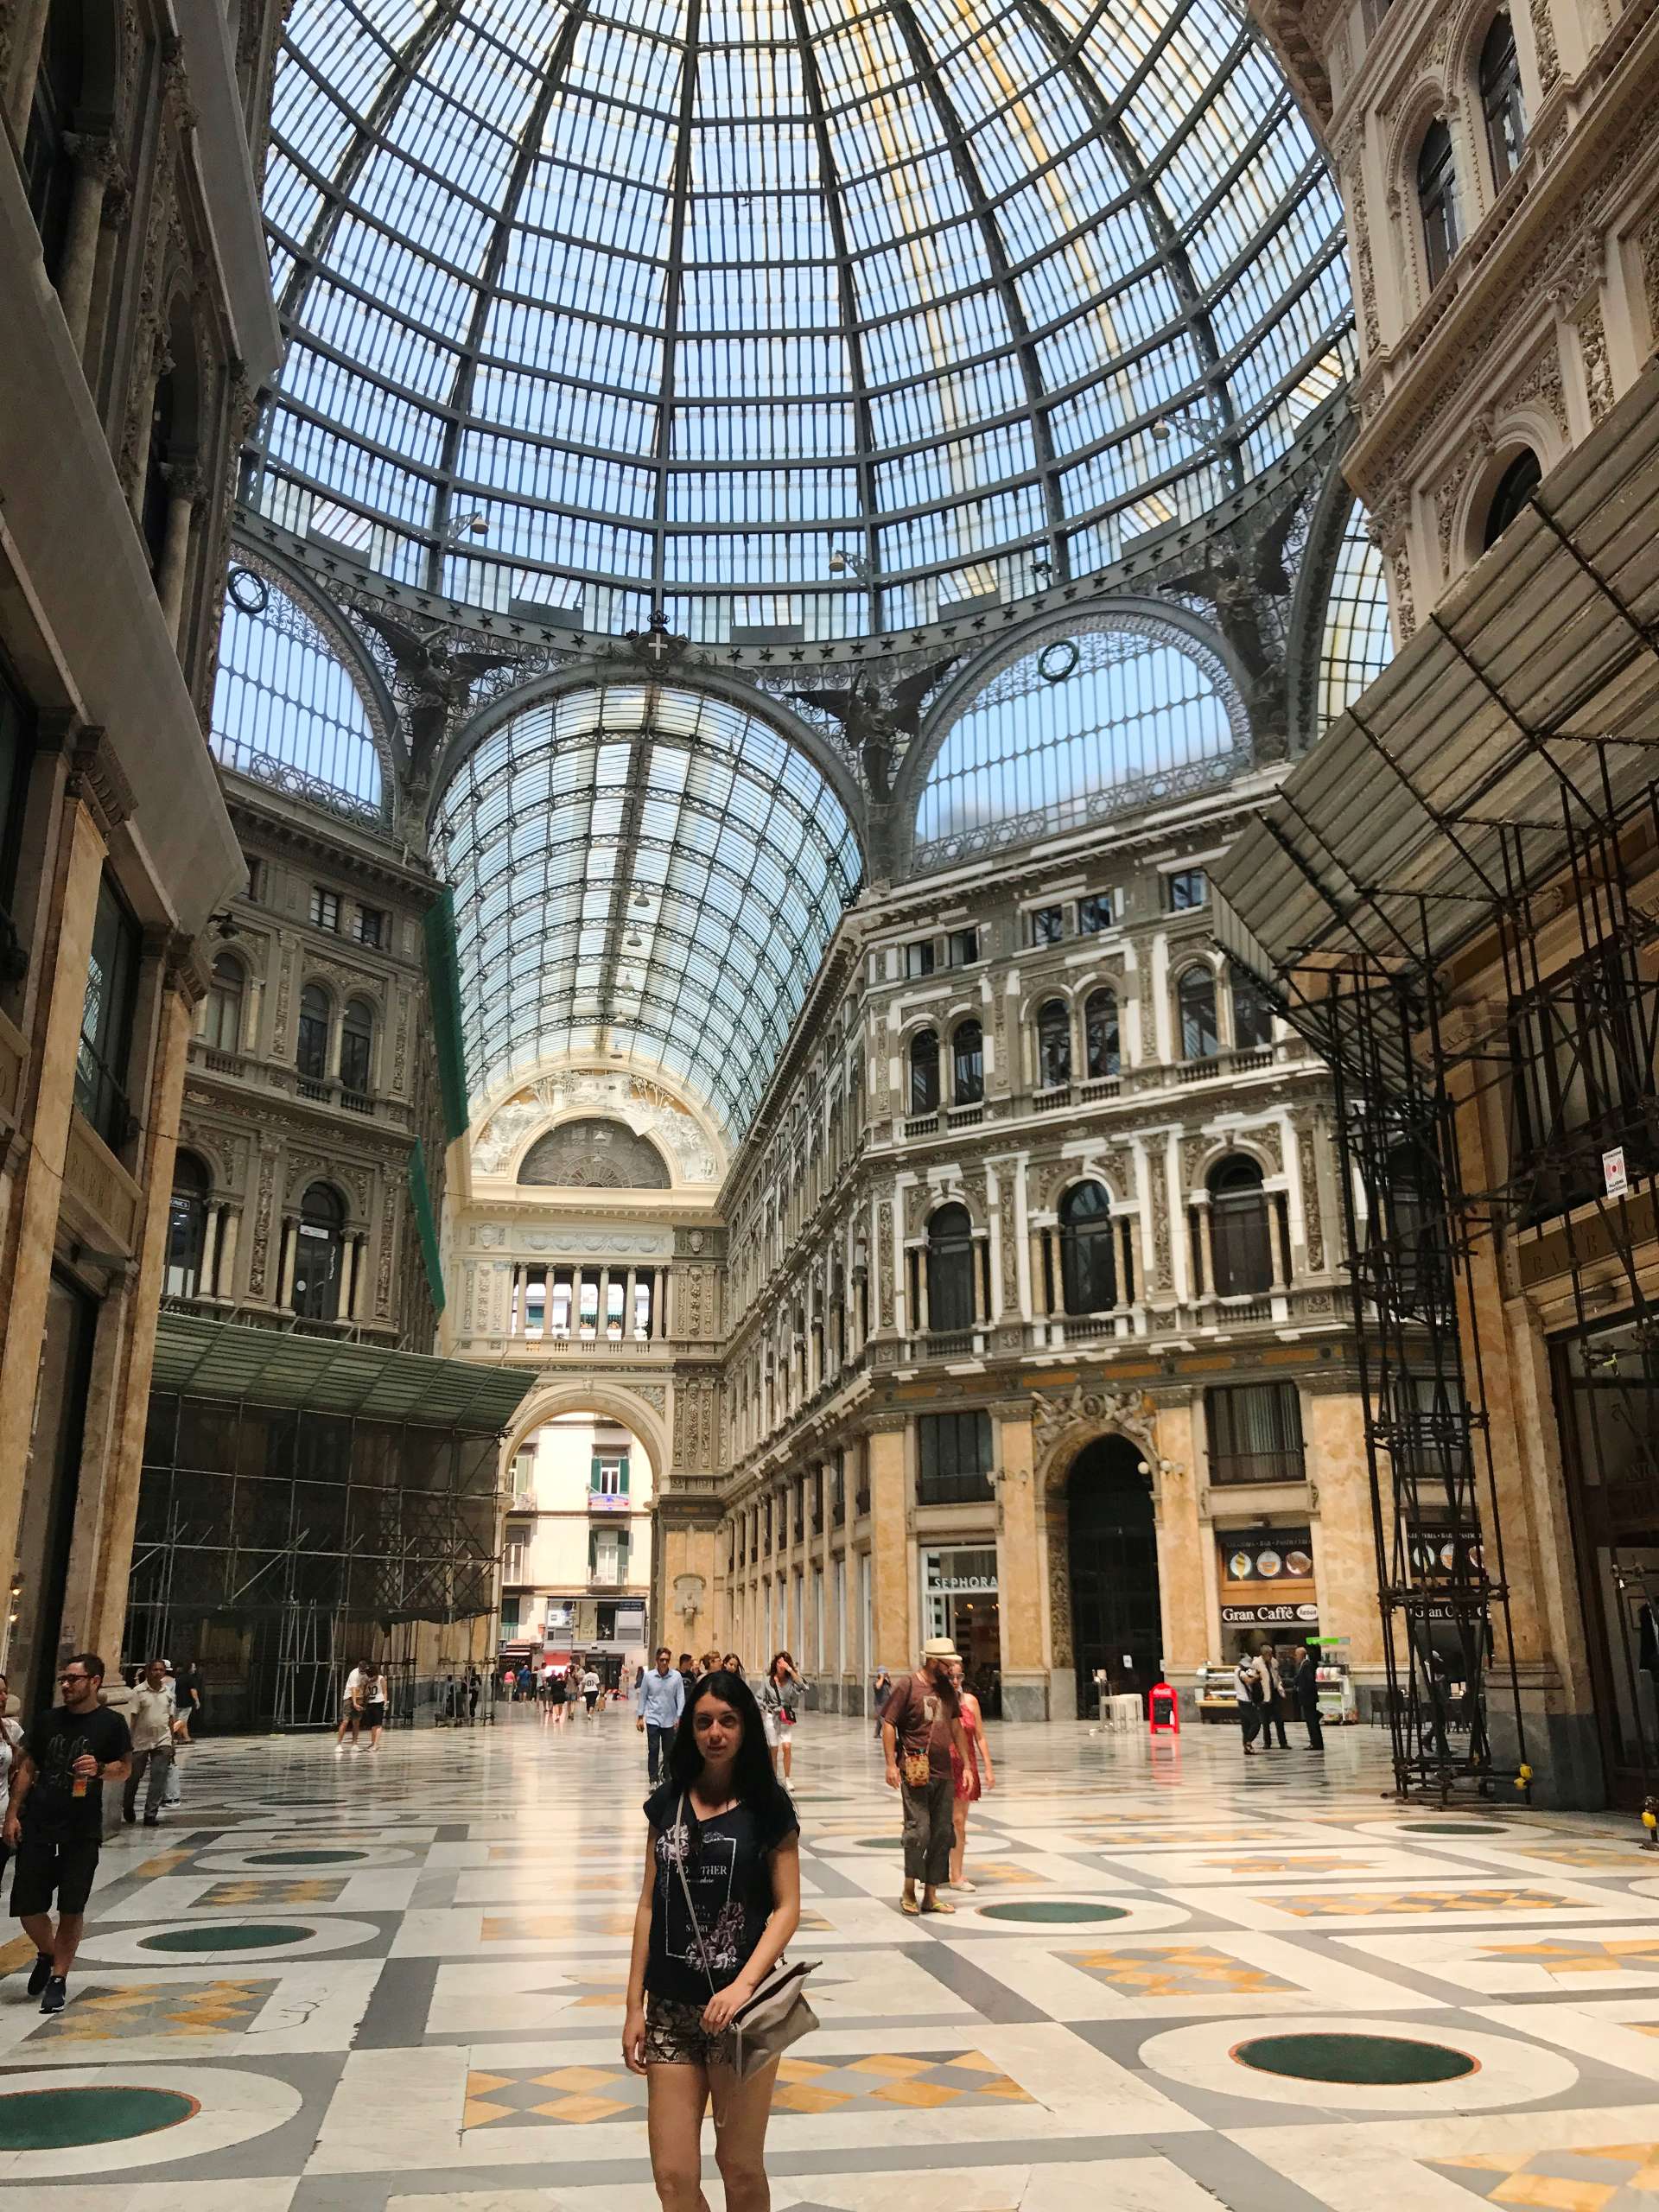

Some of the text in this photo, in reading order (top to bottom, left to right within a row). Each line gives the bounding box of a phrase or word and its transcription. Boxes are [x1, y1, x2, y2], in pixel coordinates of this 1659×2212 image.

[934, 1576, 998, 1589] SEPHORA
[1222, 1606, 1294, 1621] Gran Caffè
